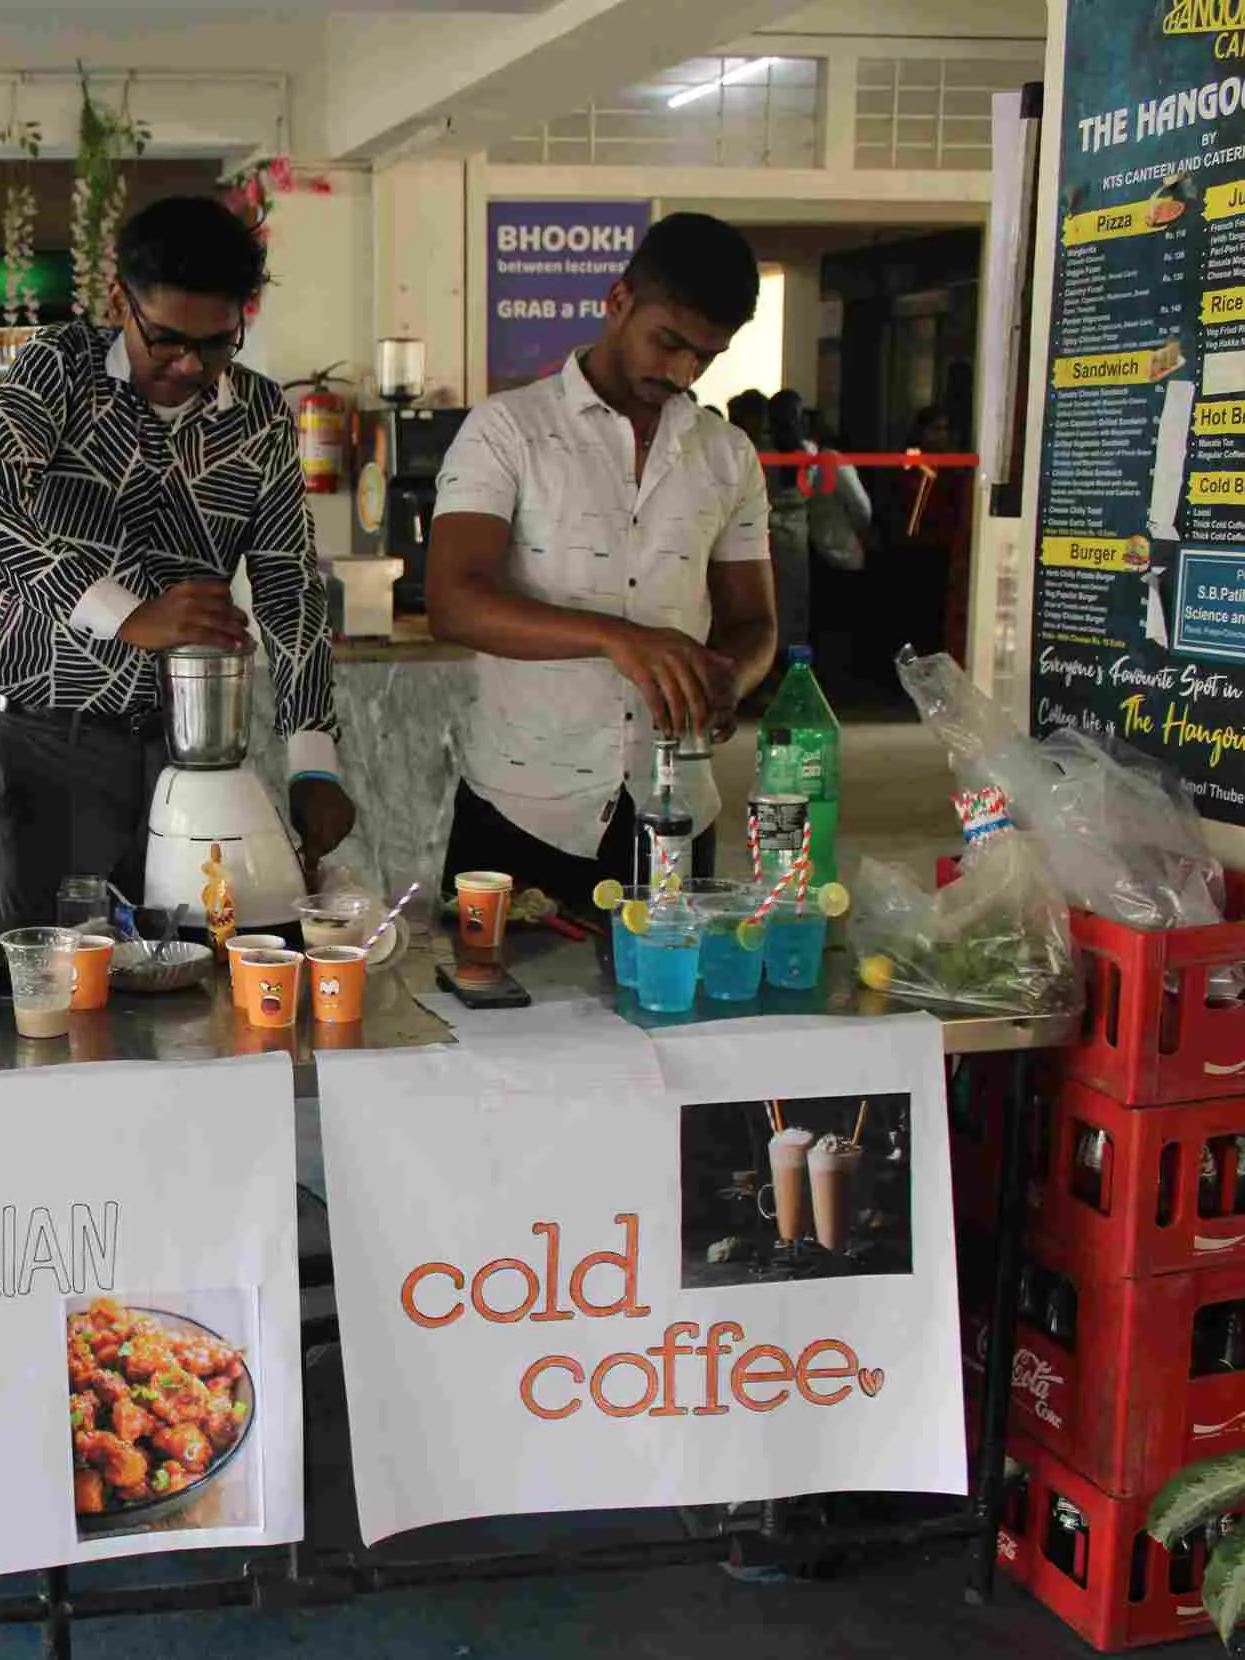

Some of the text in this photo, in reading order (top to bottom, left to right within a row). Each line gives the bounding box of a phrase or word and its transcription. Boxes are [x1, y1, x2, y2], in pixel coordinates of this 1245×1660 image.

[1078, 76, 1245, 153] THE HANGO
[1201, 130, 1218, 146] BY
[1102, 175, 1124, 190] KTS
[1125, 163, 1176, 185] CANTEEN
[1177, 156, 1202, 174] AND
[1096, 214, 1132, 233] Pizza
[497, 225, 635, 251] BHOOKH
[498, 259, 563, 274] between
[497, 300, 557, 319] GRAB
[561, 303, 574, 318] a
[1211, 294, 1243, 315] Rice
[1073, 358, 1139, 380] Sandwich
[1200, 408, 1228, 426] Hot
[1200, 477, 1230, 493] Cold
[1070, 543, 1117, 564] Burger
[1185, 606, 1228, 623] Science
[1039, 645, 1243, 702] Everyone's Favourite Spot in
[1120, 693, 1155, 738] The
[400, 1213, 652, 1329] cold
[519, 1321, 860, 1420] coffee
